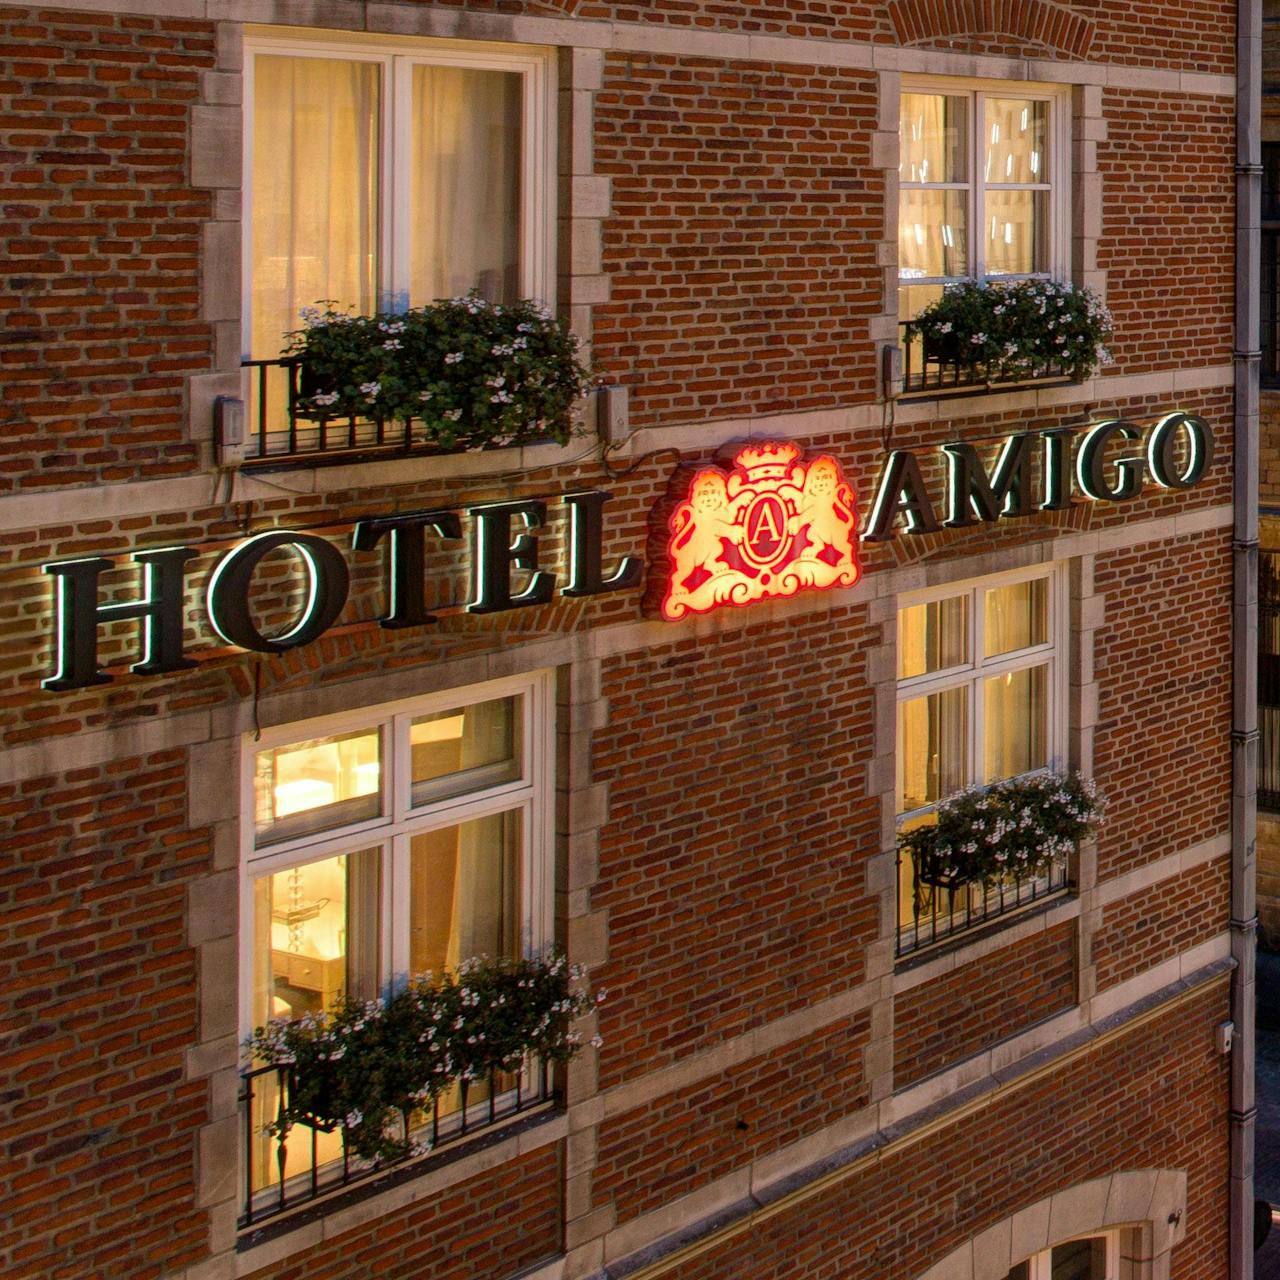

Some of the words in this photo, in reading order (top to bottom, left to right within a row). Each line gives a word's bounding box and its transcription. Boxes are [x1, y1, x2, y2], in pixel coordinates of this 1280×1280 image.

[41, 489, 646, 692] HOTEL
[858, 411, 1214, 542] AMIGO
[749, 501, 783, 546] A
